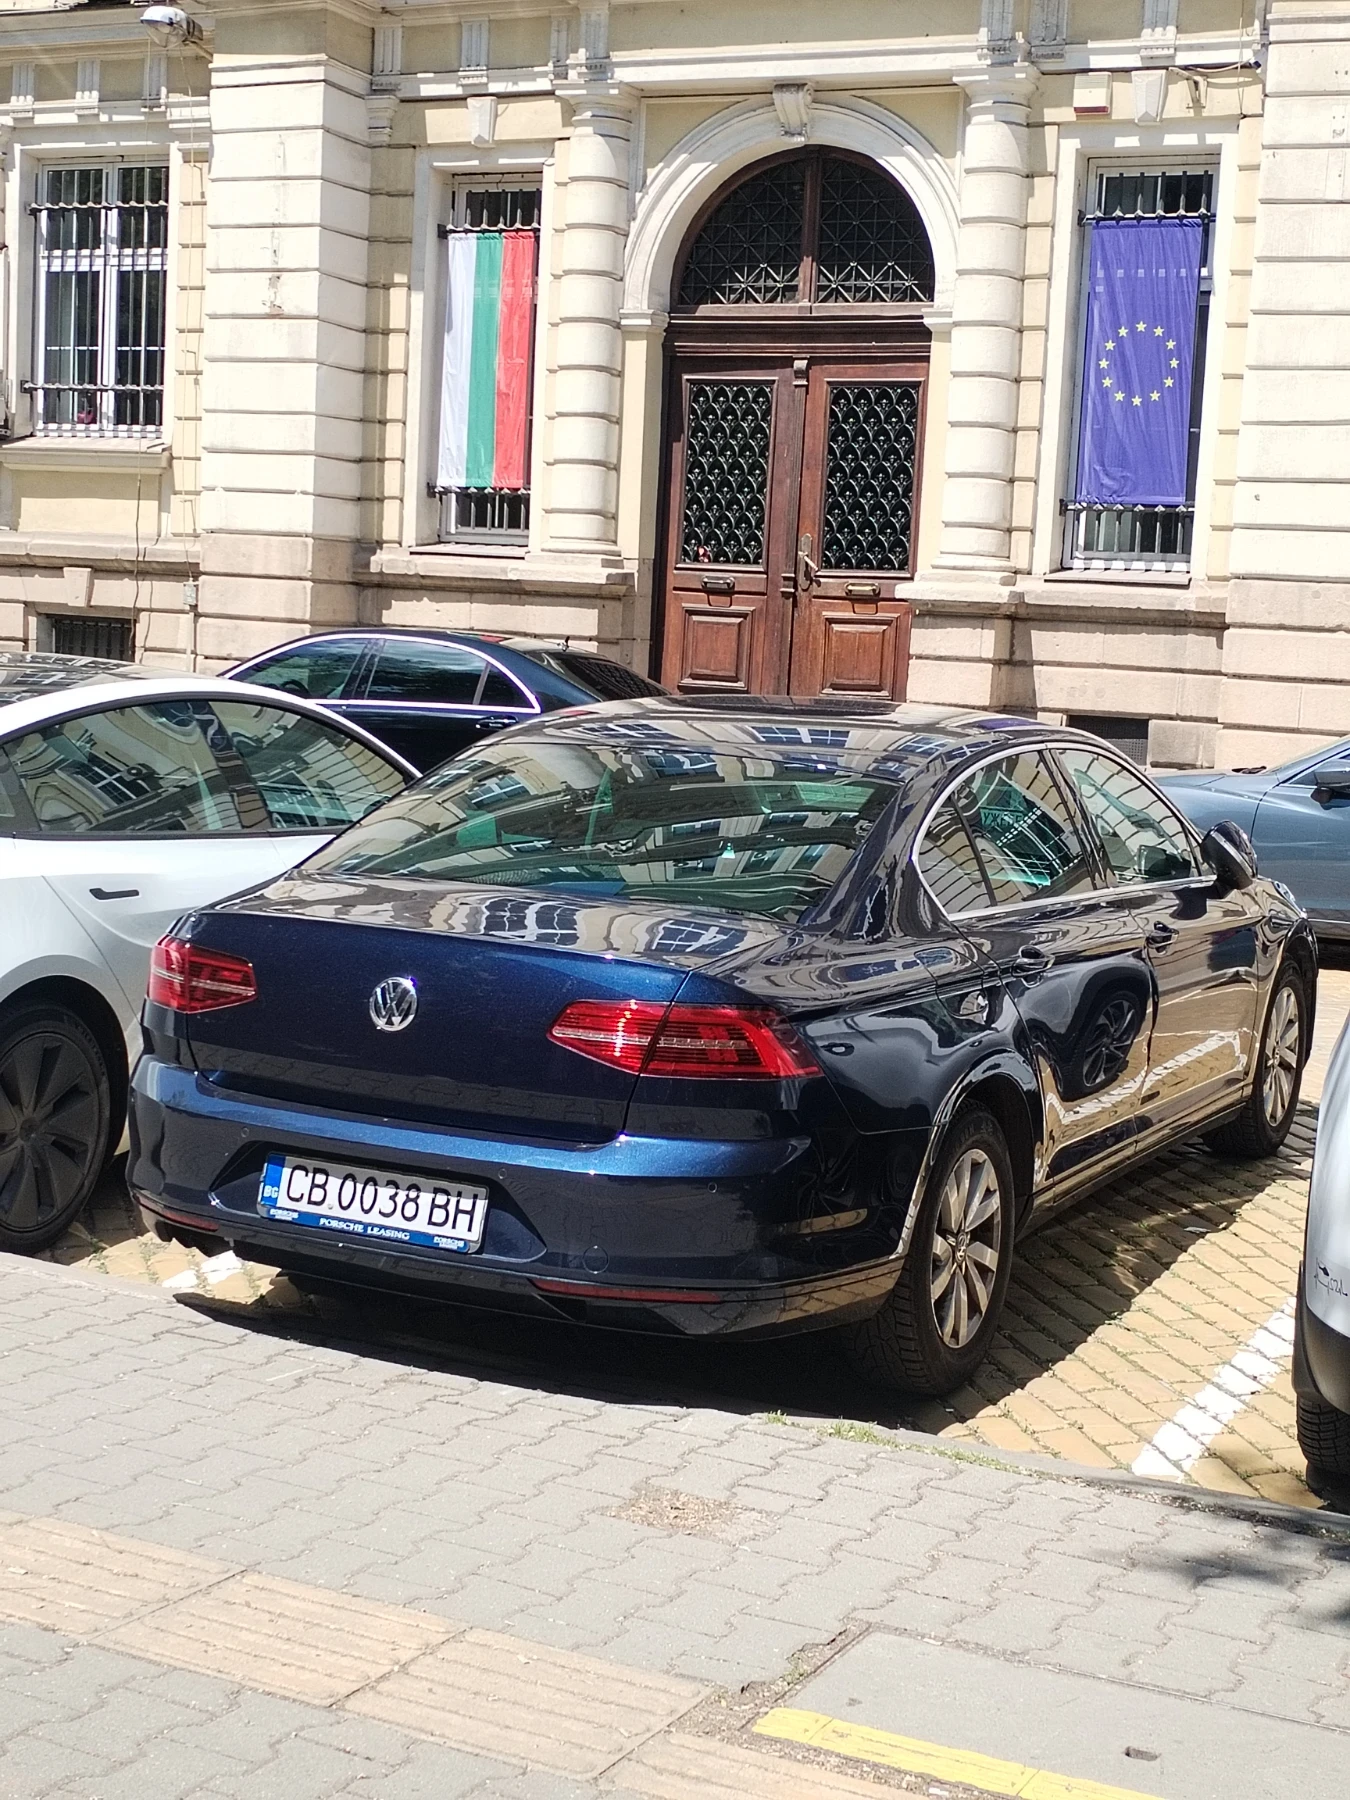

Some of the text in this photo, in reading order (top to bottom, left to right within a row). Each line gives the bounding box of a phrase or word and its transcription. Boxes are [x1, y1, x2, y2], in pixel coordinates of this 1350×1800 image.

[263, 1184, 279, 1199] BG
[337, 1172, 421, 1222] 0038
[319, 1217, 410, 1240] PORSCHE LEASING
